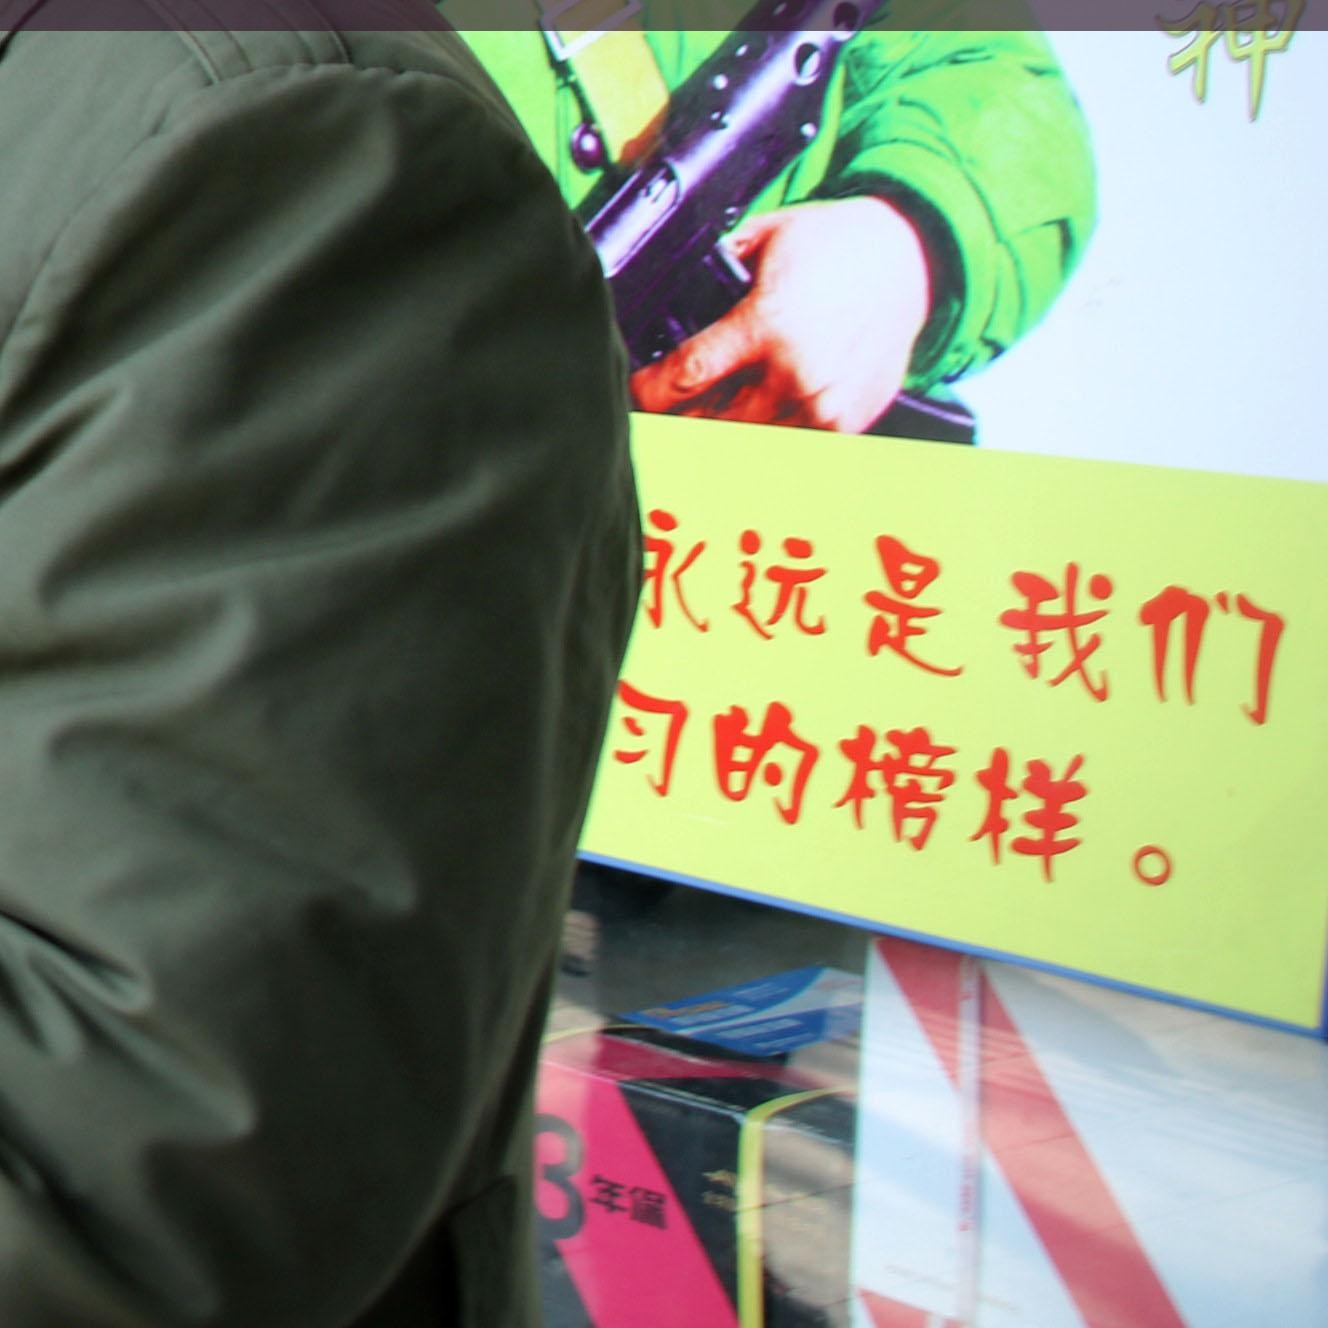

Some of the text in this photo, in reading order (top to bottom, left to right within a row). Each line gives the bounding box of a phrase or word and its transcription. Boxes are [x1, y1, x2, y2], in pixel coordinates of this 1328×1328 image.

[643, 508, 1286, 725] 永远是我们
